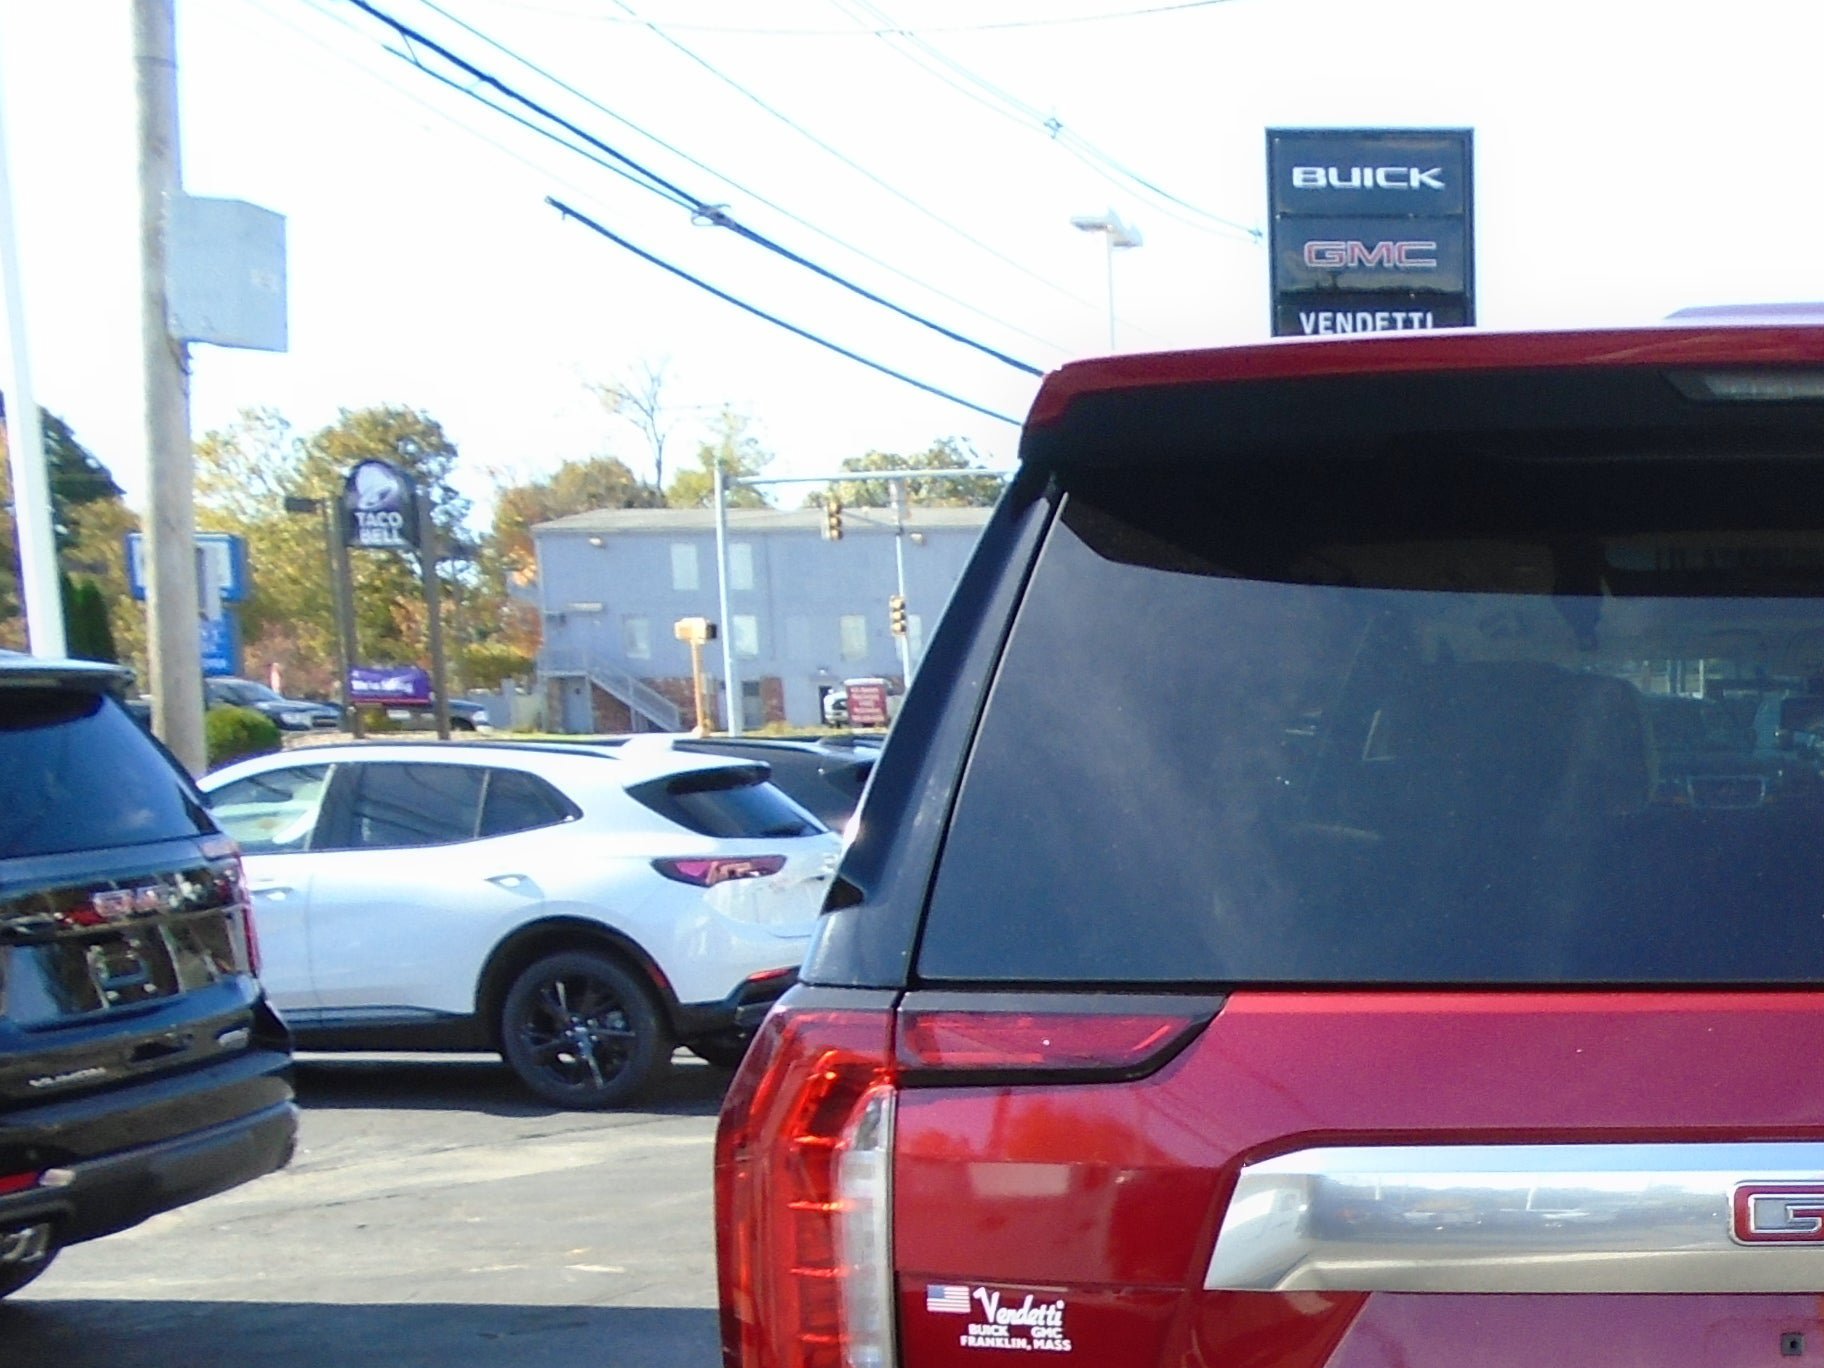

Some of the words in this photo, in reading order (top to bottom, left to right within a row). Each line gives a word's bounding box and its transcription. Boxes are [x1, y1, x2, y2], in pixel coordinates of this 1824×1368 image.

[1292, 166, 1445, 189] BUICK
[1303, 240, 1438, 268] GMC
[1299, 311, 1434, 335] VENDETTI
[354, 511, 404, 528] TACO
[359, 528, 406, 545] BELL
[972, 1286, 1066, 1326] Vendetti
[967, 1323, 1010, 1337] BUICK
[1030, 1326, 1064, 1339] GMC
[959, 1335, 1032, 1351] FRANKLIN,
[1033, 1338, 1072, 1351] MASS
